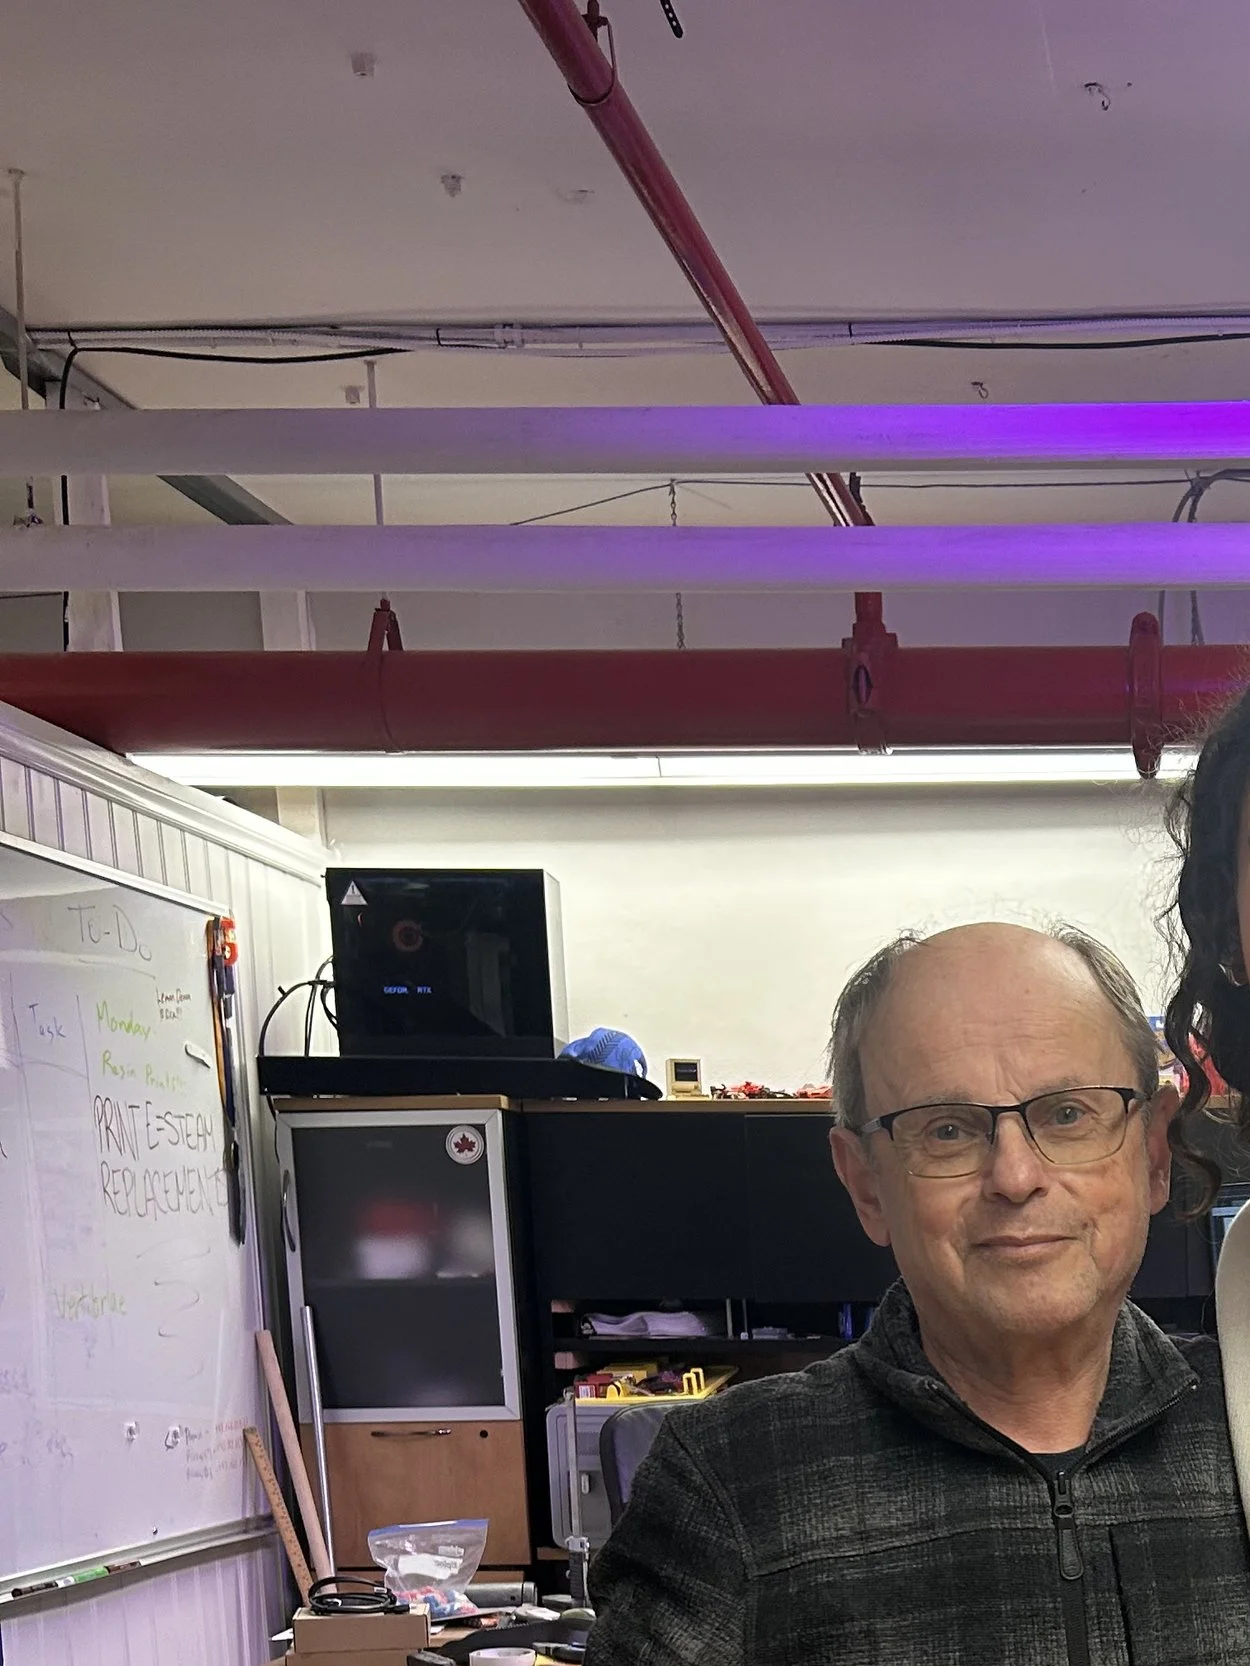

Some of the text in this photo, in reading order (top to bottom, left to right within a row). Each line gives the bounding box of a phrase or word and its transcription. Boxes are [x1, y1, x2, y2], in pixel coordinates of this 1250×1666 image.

[67, 904, 152, 962] To-Do
[29, 1003, 66, 1039] Task
[96, 1001, 151, 1041] Monday
[94, 1094, 139, 1161] PRINT
